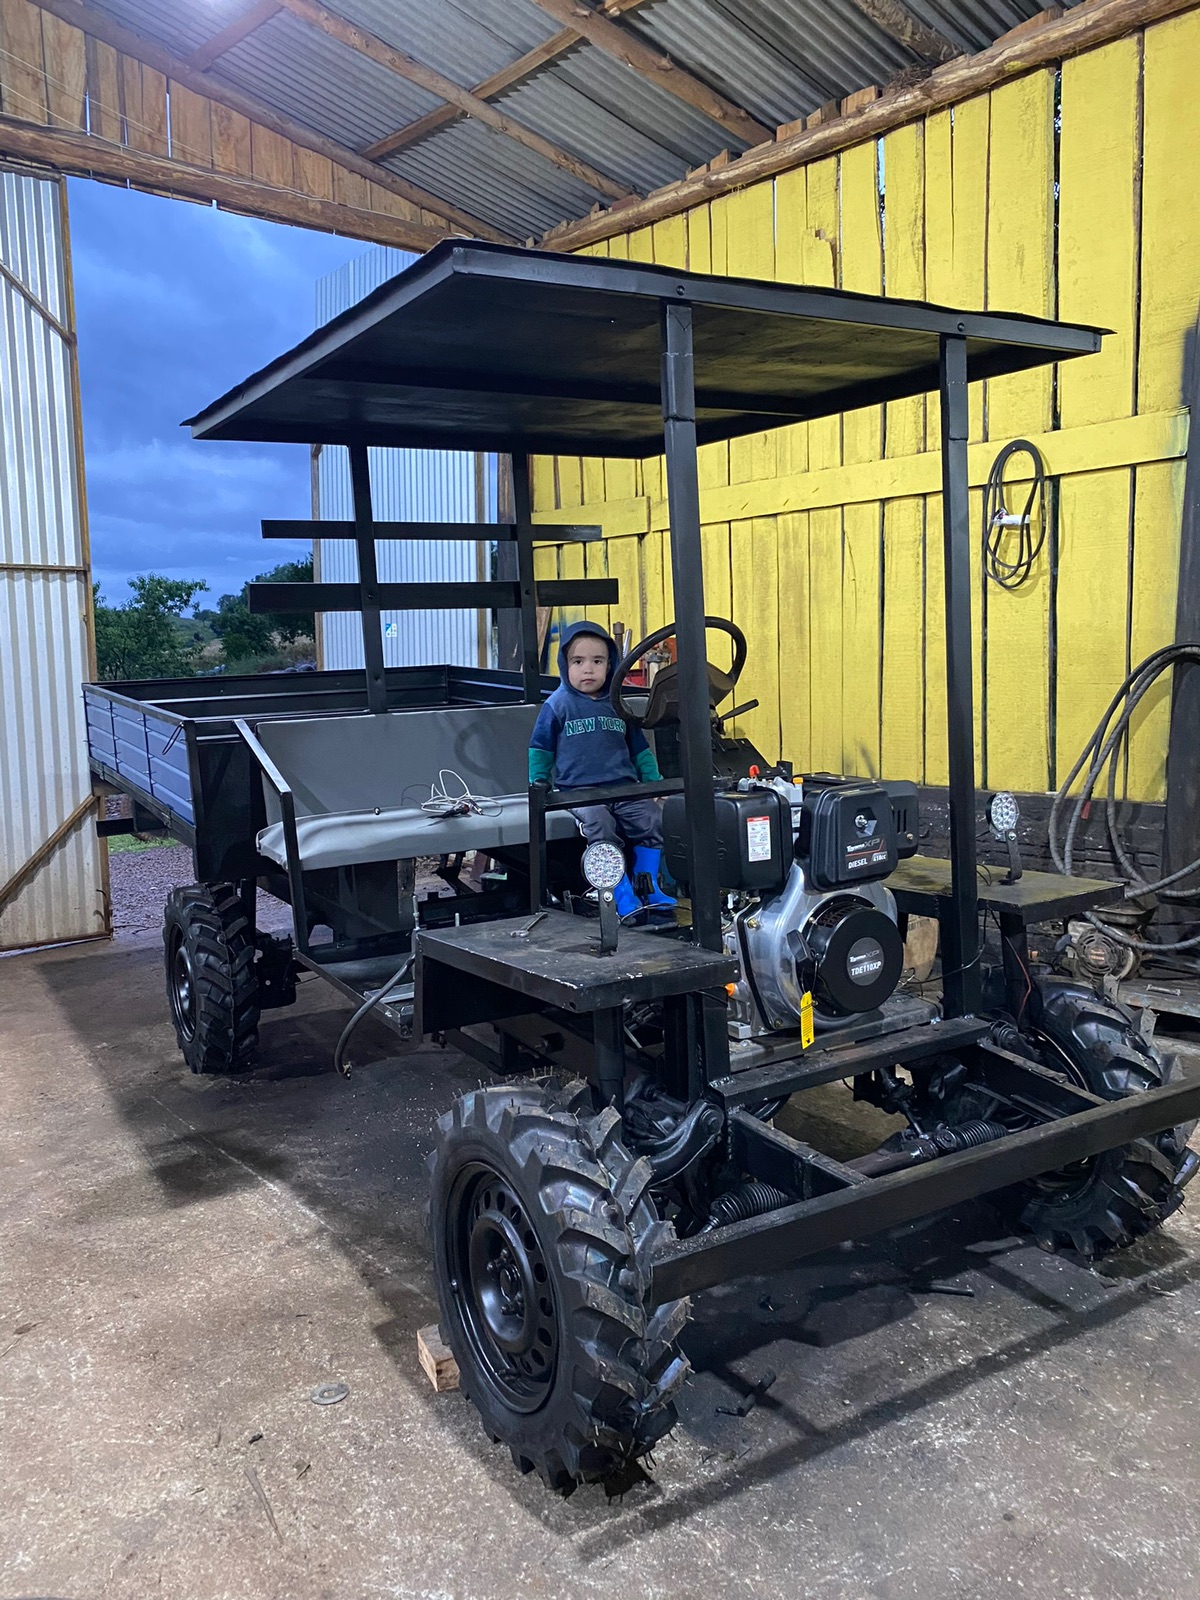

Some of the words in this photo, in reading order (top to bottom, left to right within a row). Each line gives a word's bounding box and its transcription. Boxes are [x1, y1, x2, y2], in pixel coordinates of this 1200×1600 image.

[565, 717, 596, 737] NEW
[848, 857, 868, 869] DIESEL
[851, 961, 882, 976] TDE110XP
